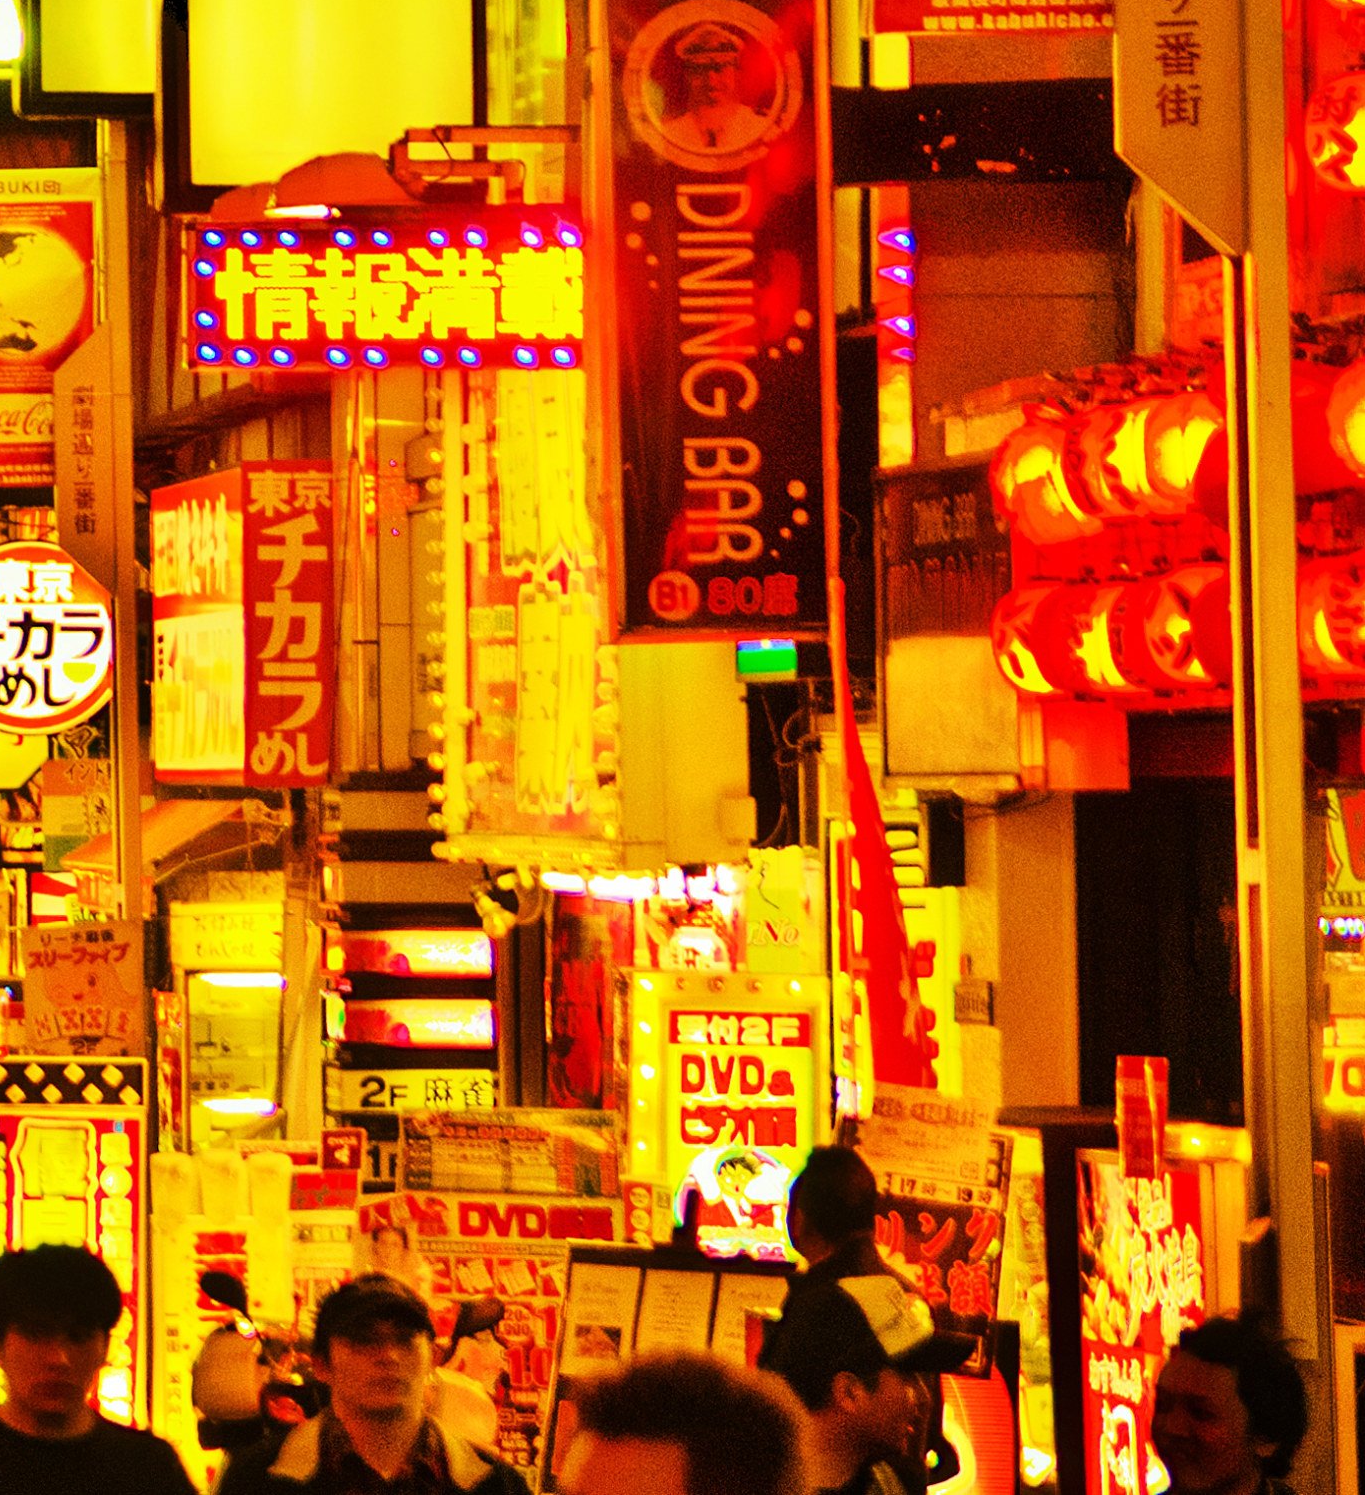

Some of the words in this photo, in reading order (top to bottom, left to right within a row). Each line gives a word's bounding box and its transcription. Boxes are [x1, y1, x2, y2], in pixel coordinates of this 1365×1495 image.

[676, 185, 759, 418] DINING
[248, 471, 334, 511] 東京
[683, 438, 764, 564] BAR
[360, 1075, 408, 1107] 2F
